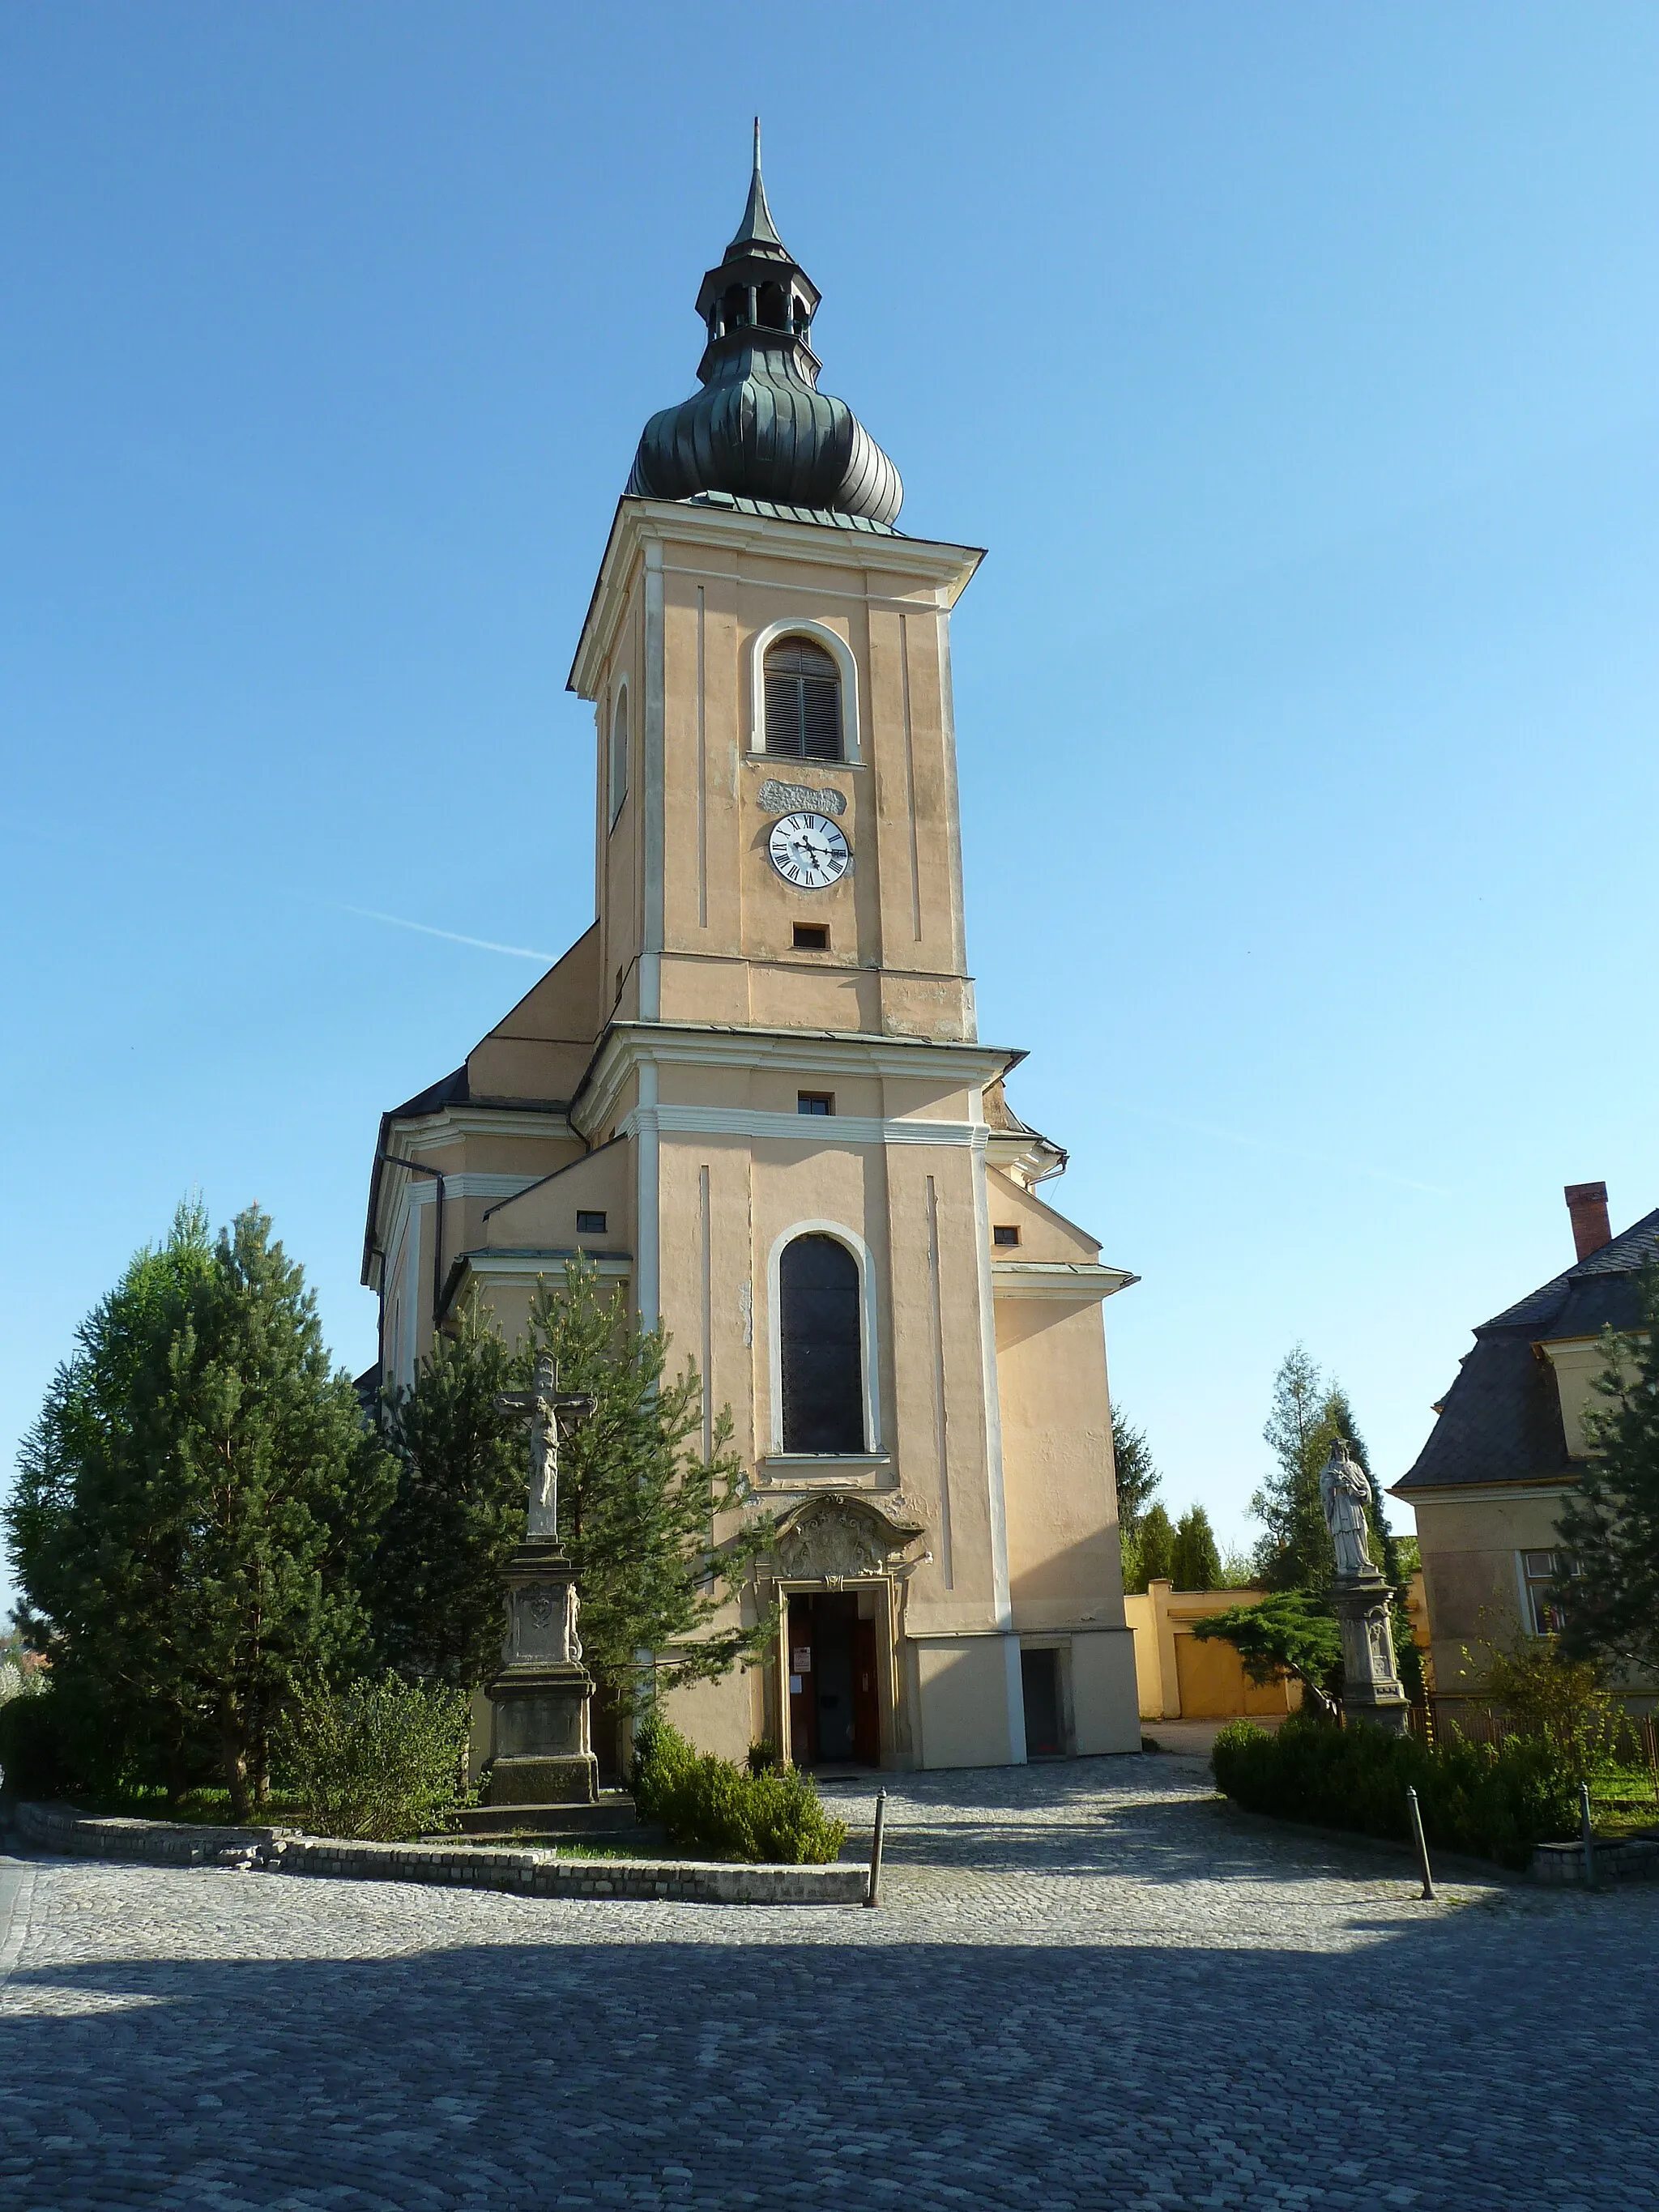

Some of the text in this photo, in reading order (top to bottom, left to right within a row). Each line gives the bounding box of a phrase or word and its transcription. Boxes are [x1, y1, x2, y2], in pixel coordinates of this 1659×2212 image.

[787, 816, 800, 831] XI
[803, 815, 814, 829] XII
[820, 821, 828, 833] I
[776, 827, 791, 838] X
[828, 833, 842, 843] II
[775, 854, 791, 869] VIII
[827, 859, 843, 874] IIII
[787, 865, 800, 880] VII
